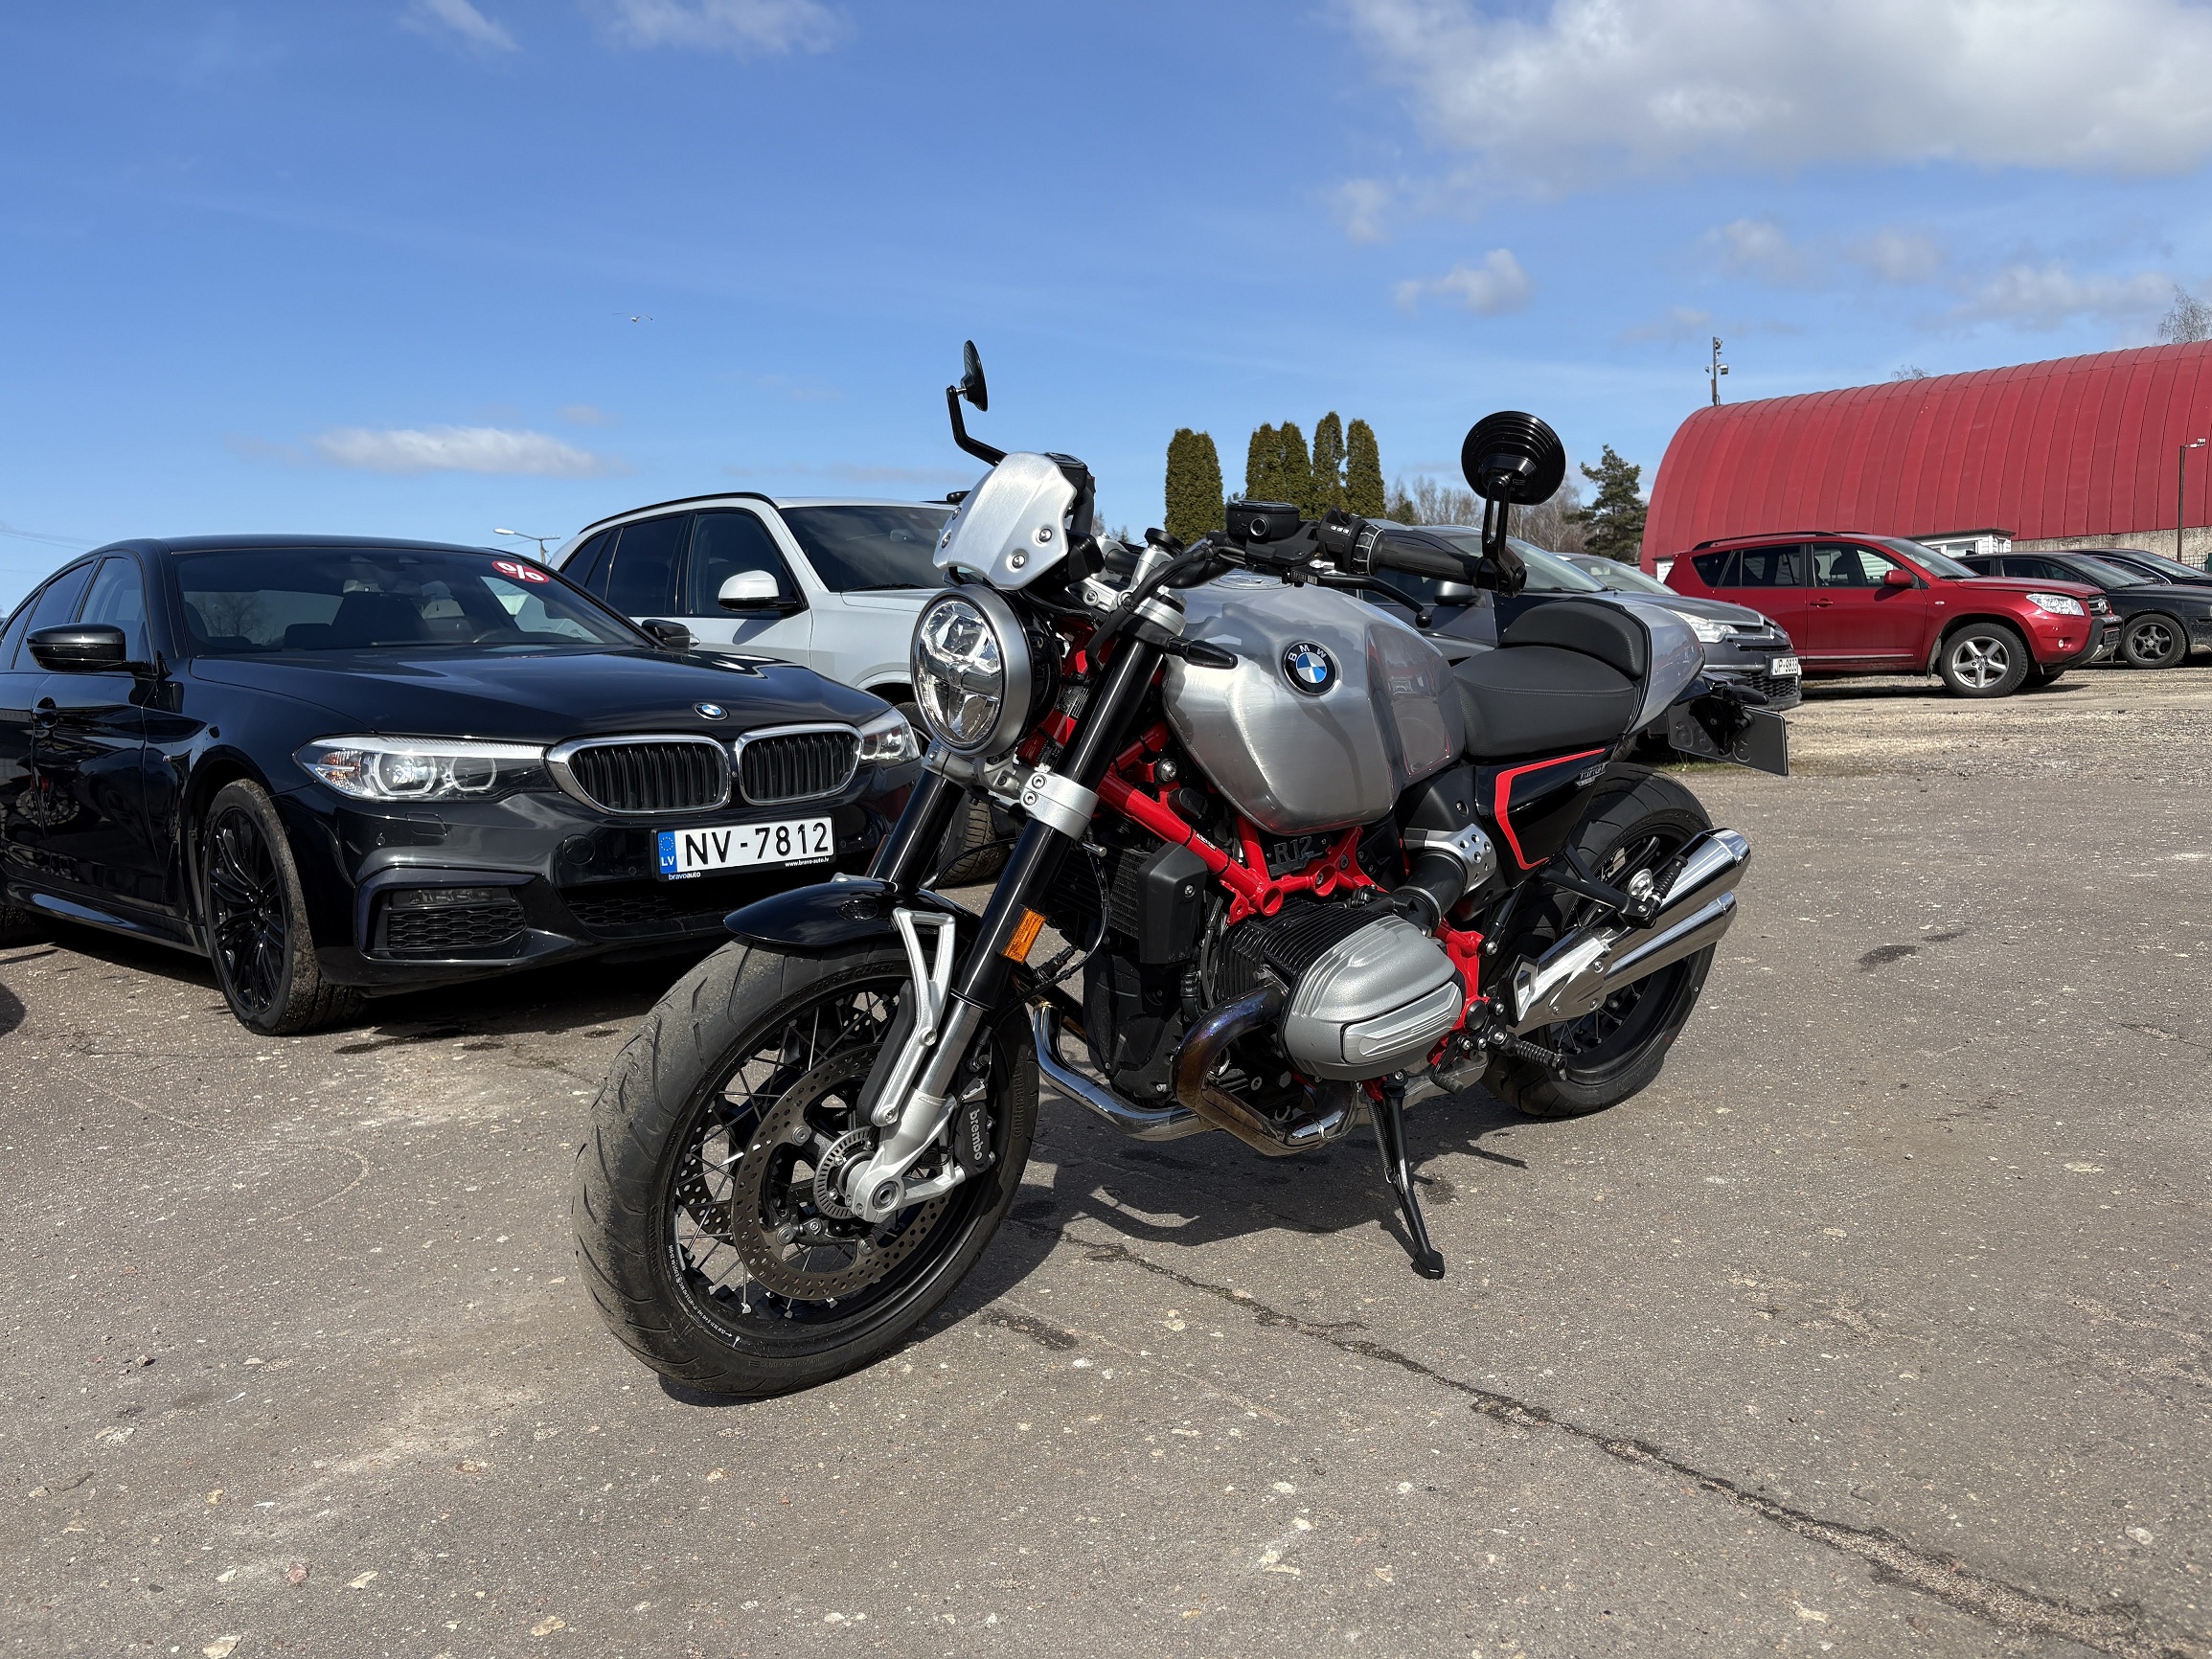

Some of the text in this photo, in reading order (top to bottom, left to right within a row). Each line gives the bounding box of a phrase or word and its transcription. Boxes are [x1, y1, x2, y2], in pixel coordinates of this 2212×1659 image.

[1288, 644, 1327, 662] BMW
[685, 822, 829, 867] NV-7812
[660, 855, 675, 867] LV
[668, 872, 701, 880] bravoauto
[969, 1108, 985, 1161] brembo
